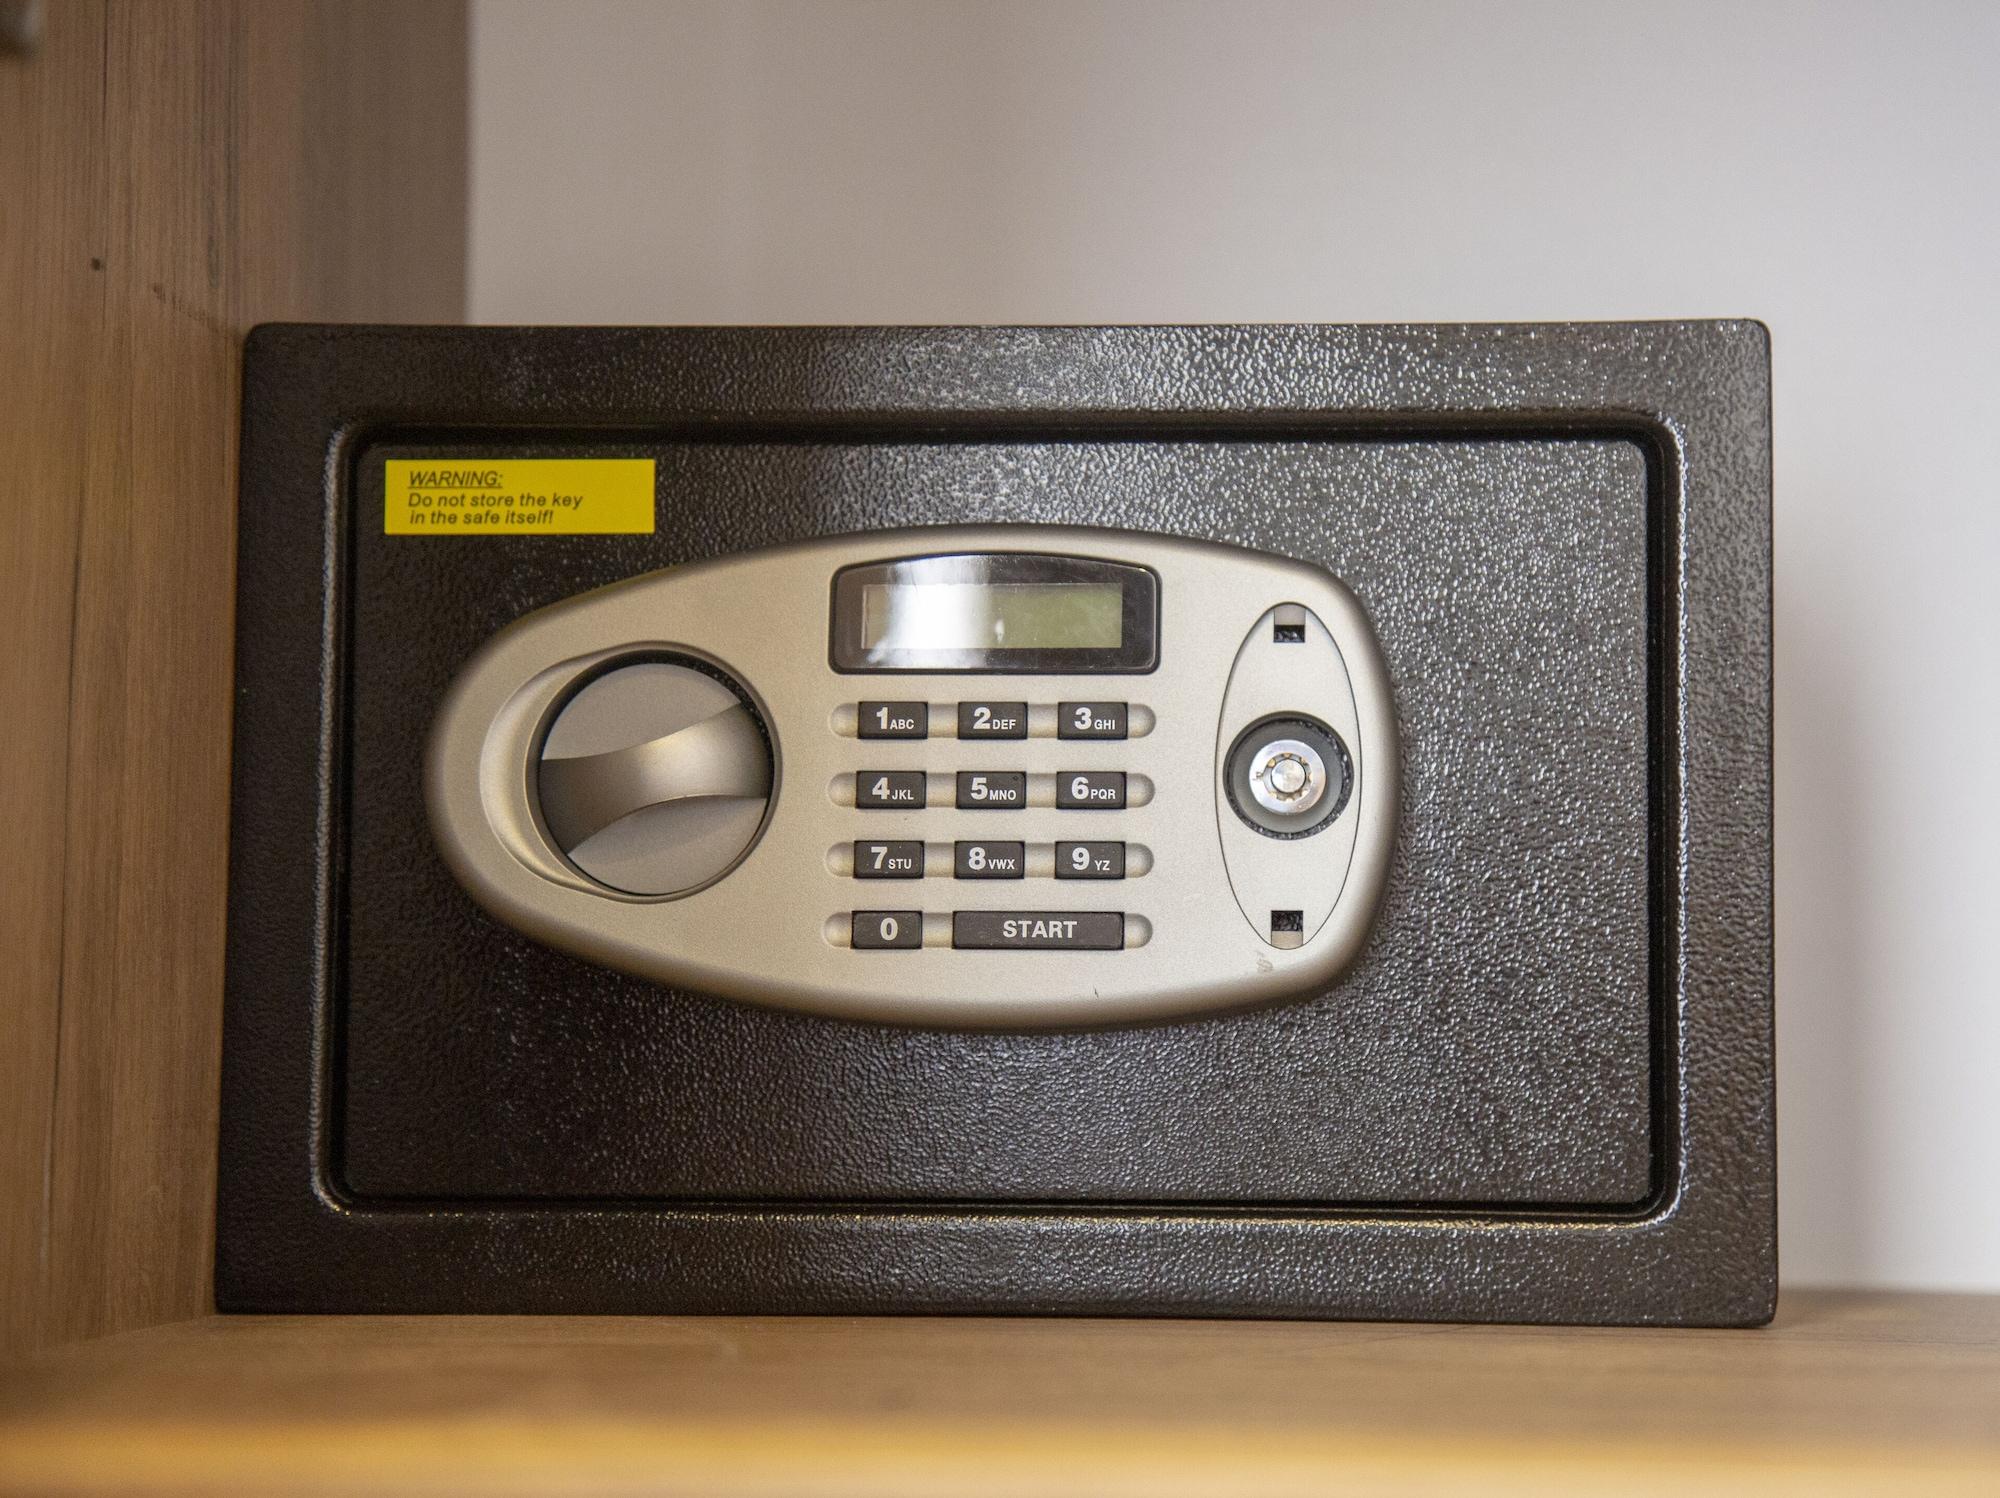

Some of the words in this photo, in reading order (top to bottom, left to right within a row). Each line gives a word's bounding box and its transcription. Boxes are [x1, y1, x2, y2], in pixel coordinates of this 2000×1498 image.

[408, 471, 503, 488] WARNING:
[408, 493, 432, 507] Do
[438, 493, 465, 507] not
[470, 494, 514, 507] store
[519, 493, 546, 507] the
[552, 493, 583, 510] key
[410, 510, 425, 524] in
[430, 510, 457, 524] the
[463, 510, 500, 524] safe
[505, 510, 553, 524] itself!
[879, 917, 899, 941] 0
[1002, 920, 1078, 939] START
